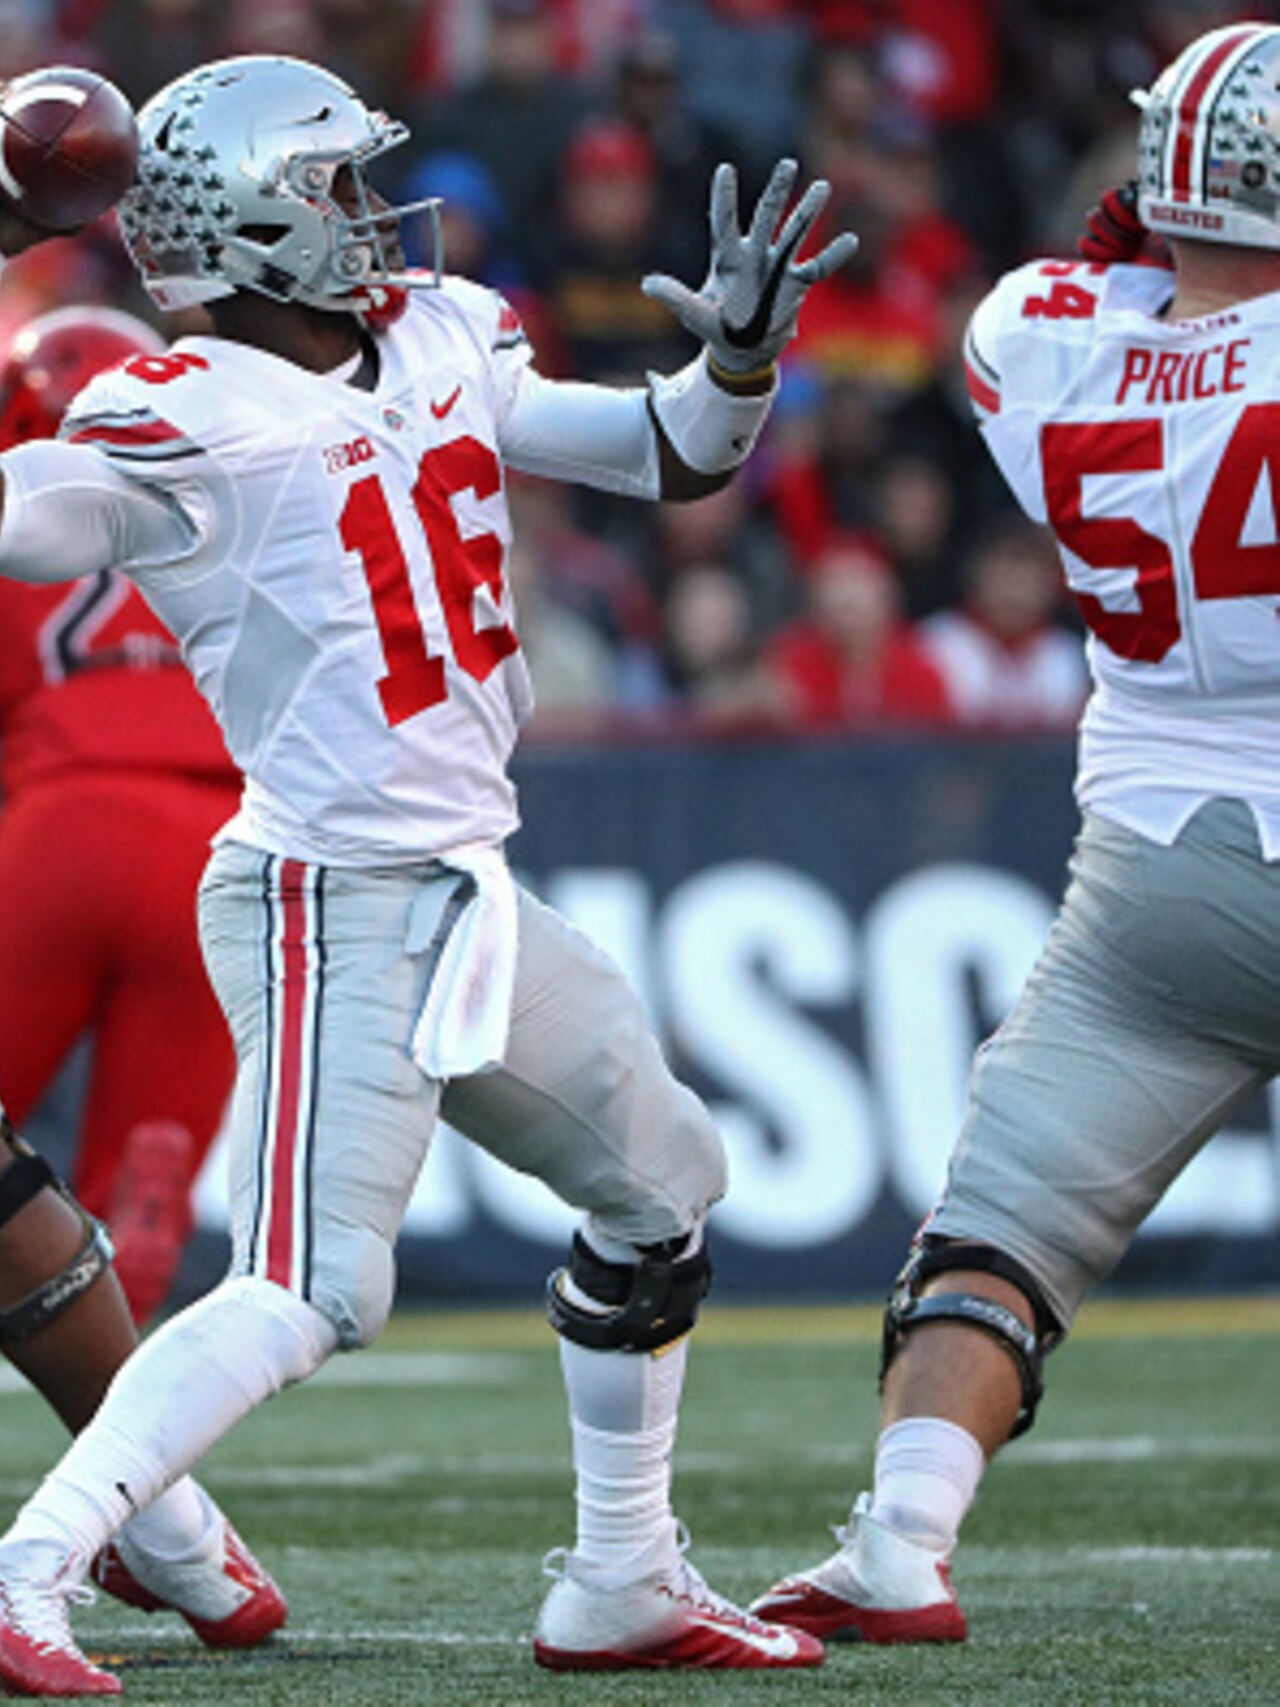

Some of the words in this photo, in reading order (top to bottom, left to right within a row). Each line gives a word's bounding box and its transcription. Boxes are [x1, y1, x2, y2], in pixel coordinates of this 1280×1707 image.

[1115, 338, 1252, 405] PRICE
[336, 434, 521, 729] 16
[1038, 402, 1280, 665] 54
